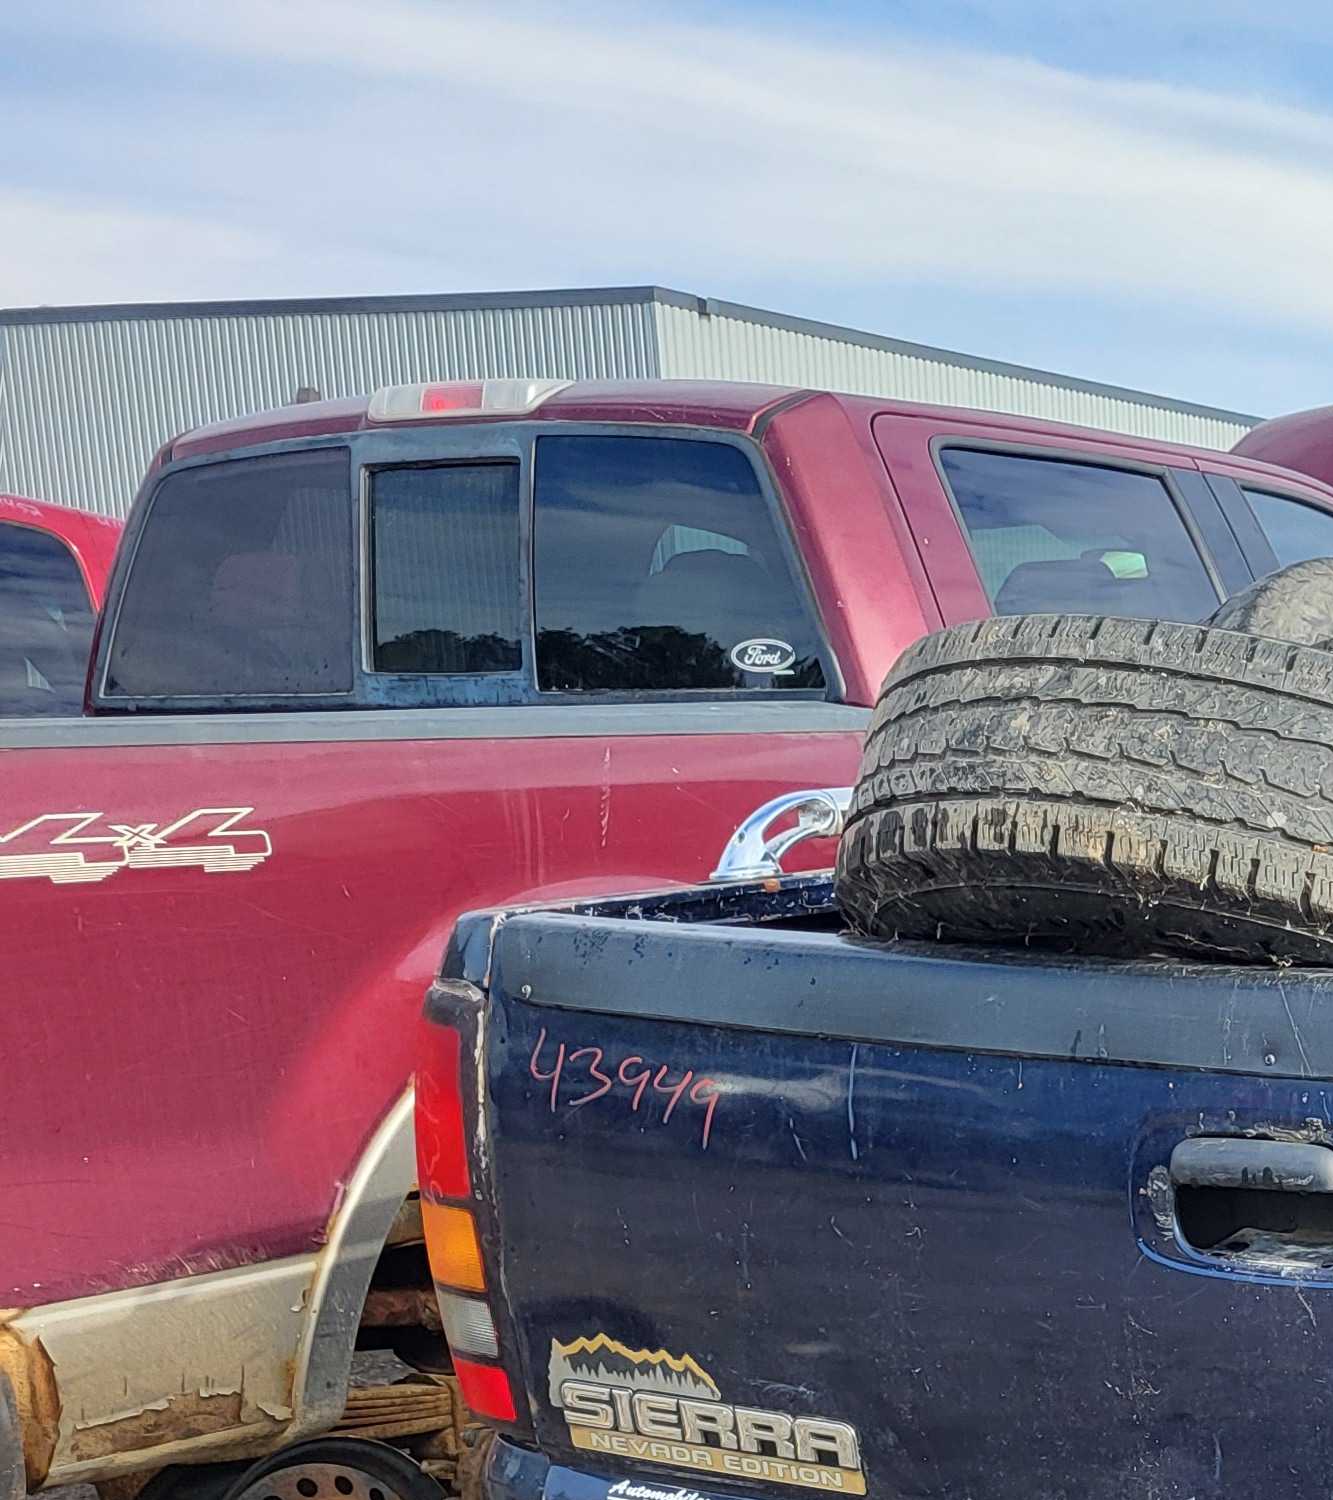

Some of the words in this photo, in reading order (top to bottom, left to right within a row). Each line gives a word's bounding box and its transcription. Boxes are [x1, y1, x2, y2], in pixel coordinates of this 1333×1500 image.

[743, 644, 782, 665] Ford
[529, 1027, 721, 1150] 43949
[561, 1379, 862, 1470] SIERRA
[591, 1432, 713, 1467] NEVADA
[724, 1453, 844, 1488] EDITION
